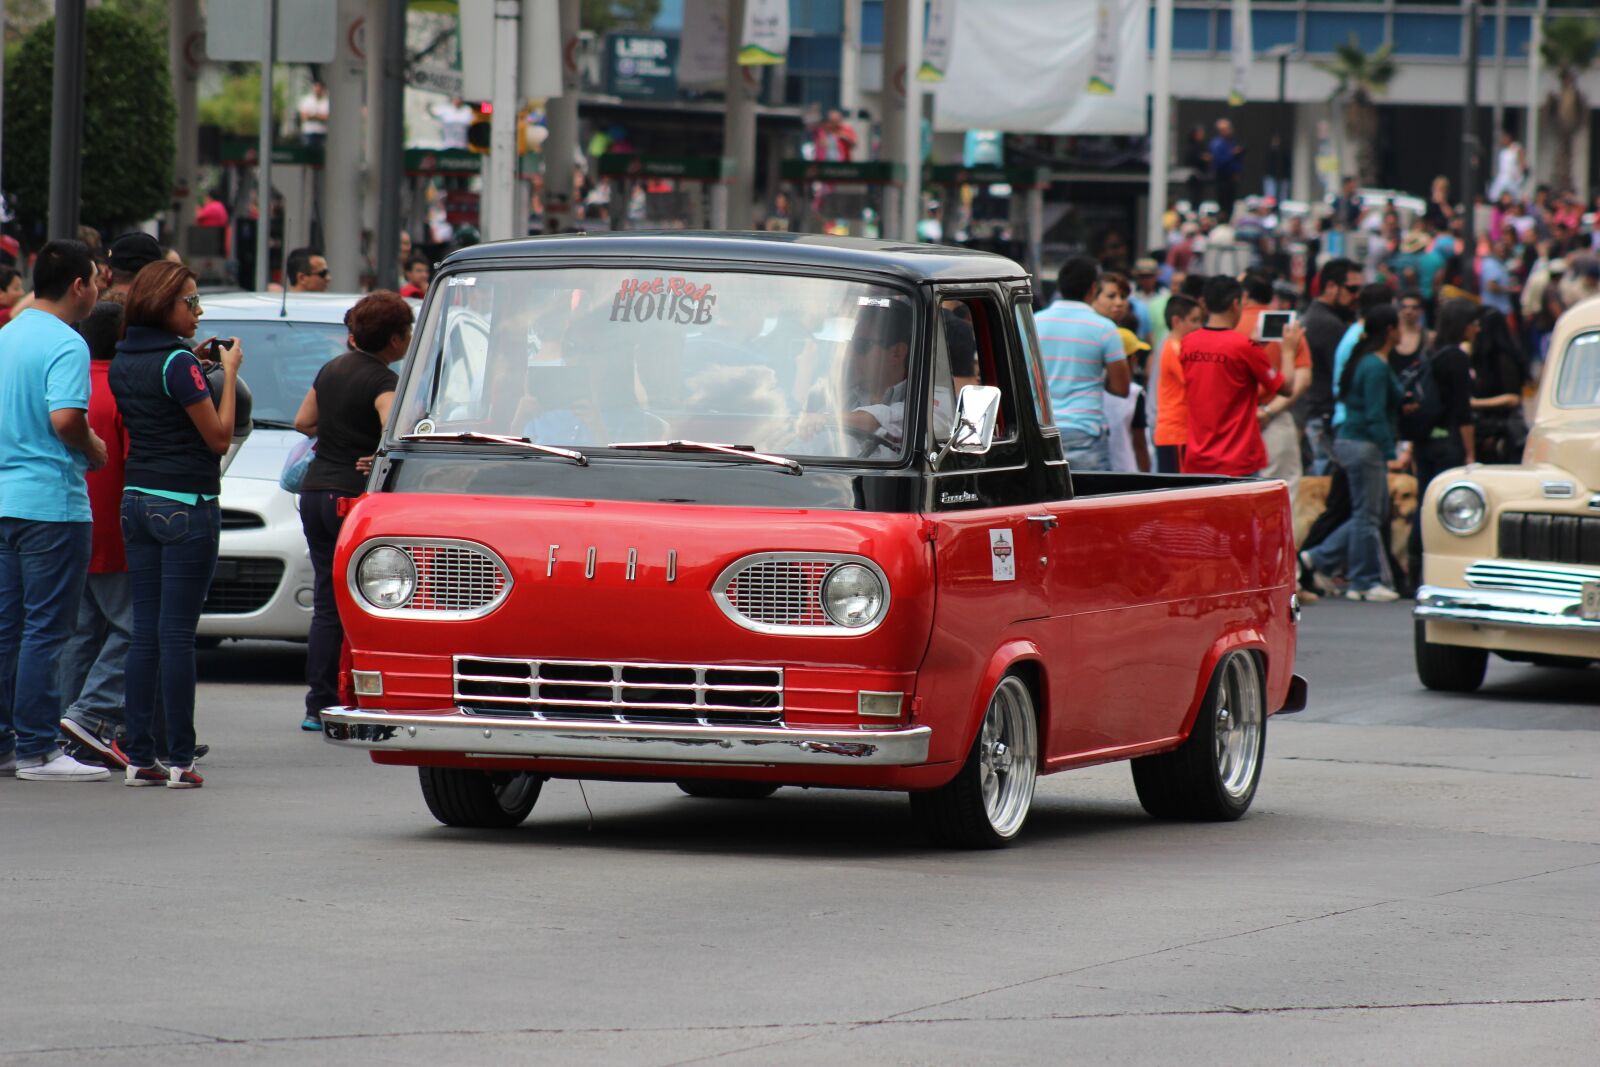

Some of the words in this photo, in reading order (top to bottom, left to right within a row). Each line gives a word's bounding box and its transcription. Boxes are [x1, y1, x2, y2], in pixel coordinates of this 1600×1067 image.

[619, 277, 664, 300] Hot
[668, 276, 712, 300] Rod
[609, 292, 717, 324] HOUSE
[546, 544, 678, 582] FORD
